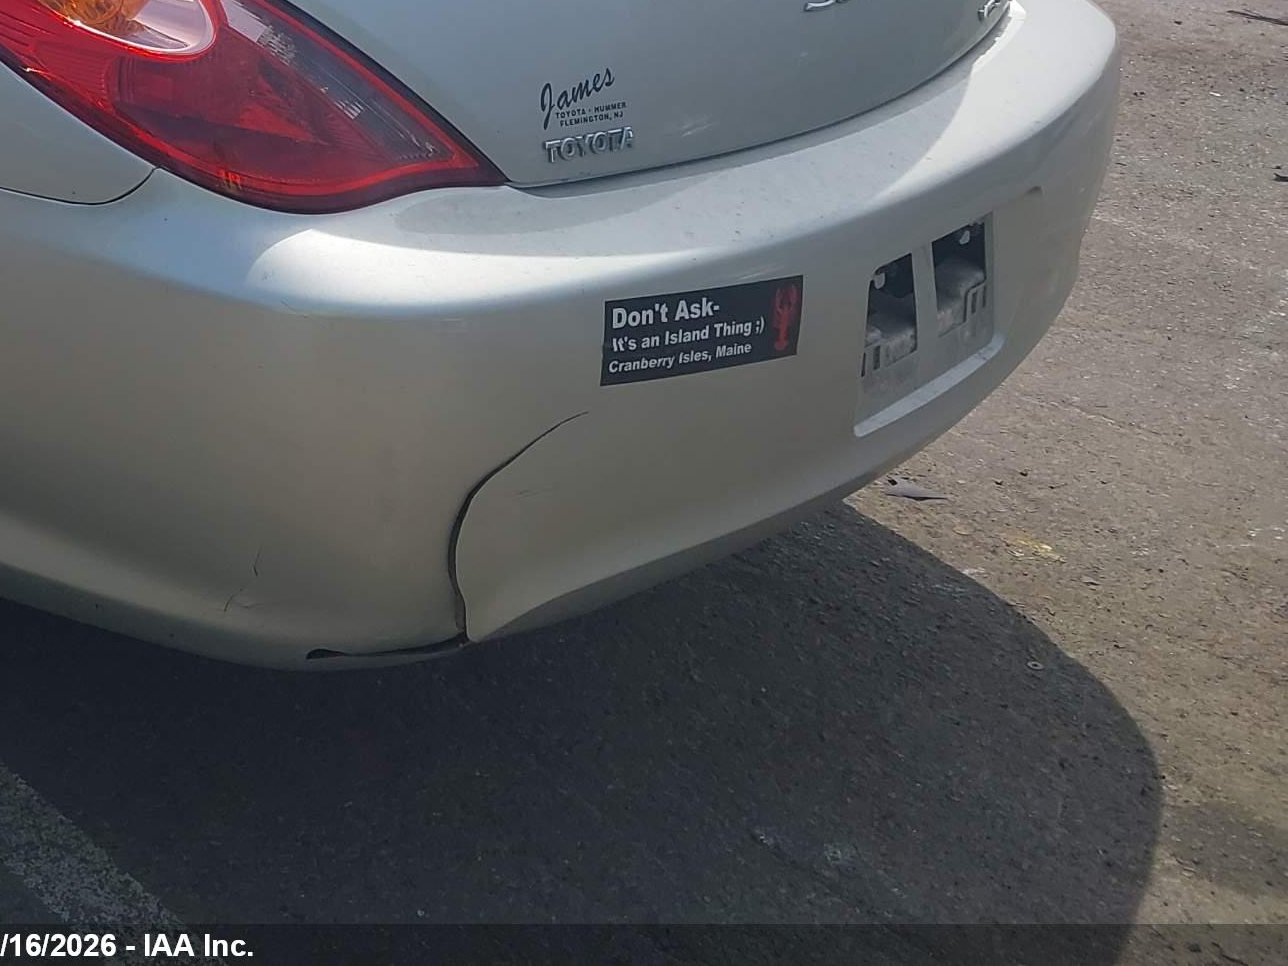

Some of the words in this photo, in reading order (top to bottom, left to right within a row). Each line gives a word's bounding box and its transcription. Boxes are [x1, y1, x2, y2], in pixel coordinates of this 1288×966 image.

[540, 67, 615, 131] James
[555, 108, 587, 119] TOYOTA
[594, 101, 627, 114] HUMMER
[560, 113, 612, 128] FLEMINGTON,
[544, 126, 633, 163] TOYOTA
[612, 302, 669, 329] Don't
[674, 297, 721, 322] Ask-
[612, 335, 638, 353] It's
[641, 335, 661, 349] an
[664, 325, 710, 346] Island
[713, 320, 753, 338] Thing
[608, 355, 676, 374] Cranberry
[678, 350, 713, 365] Isles,
[715, 342, 753, 359] Maine
